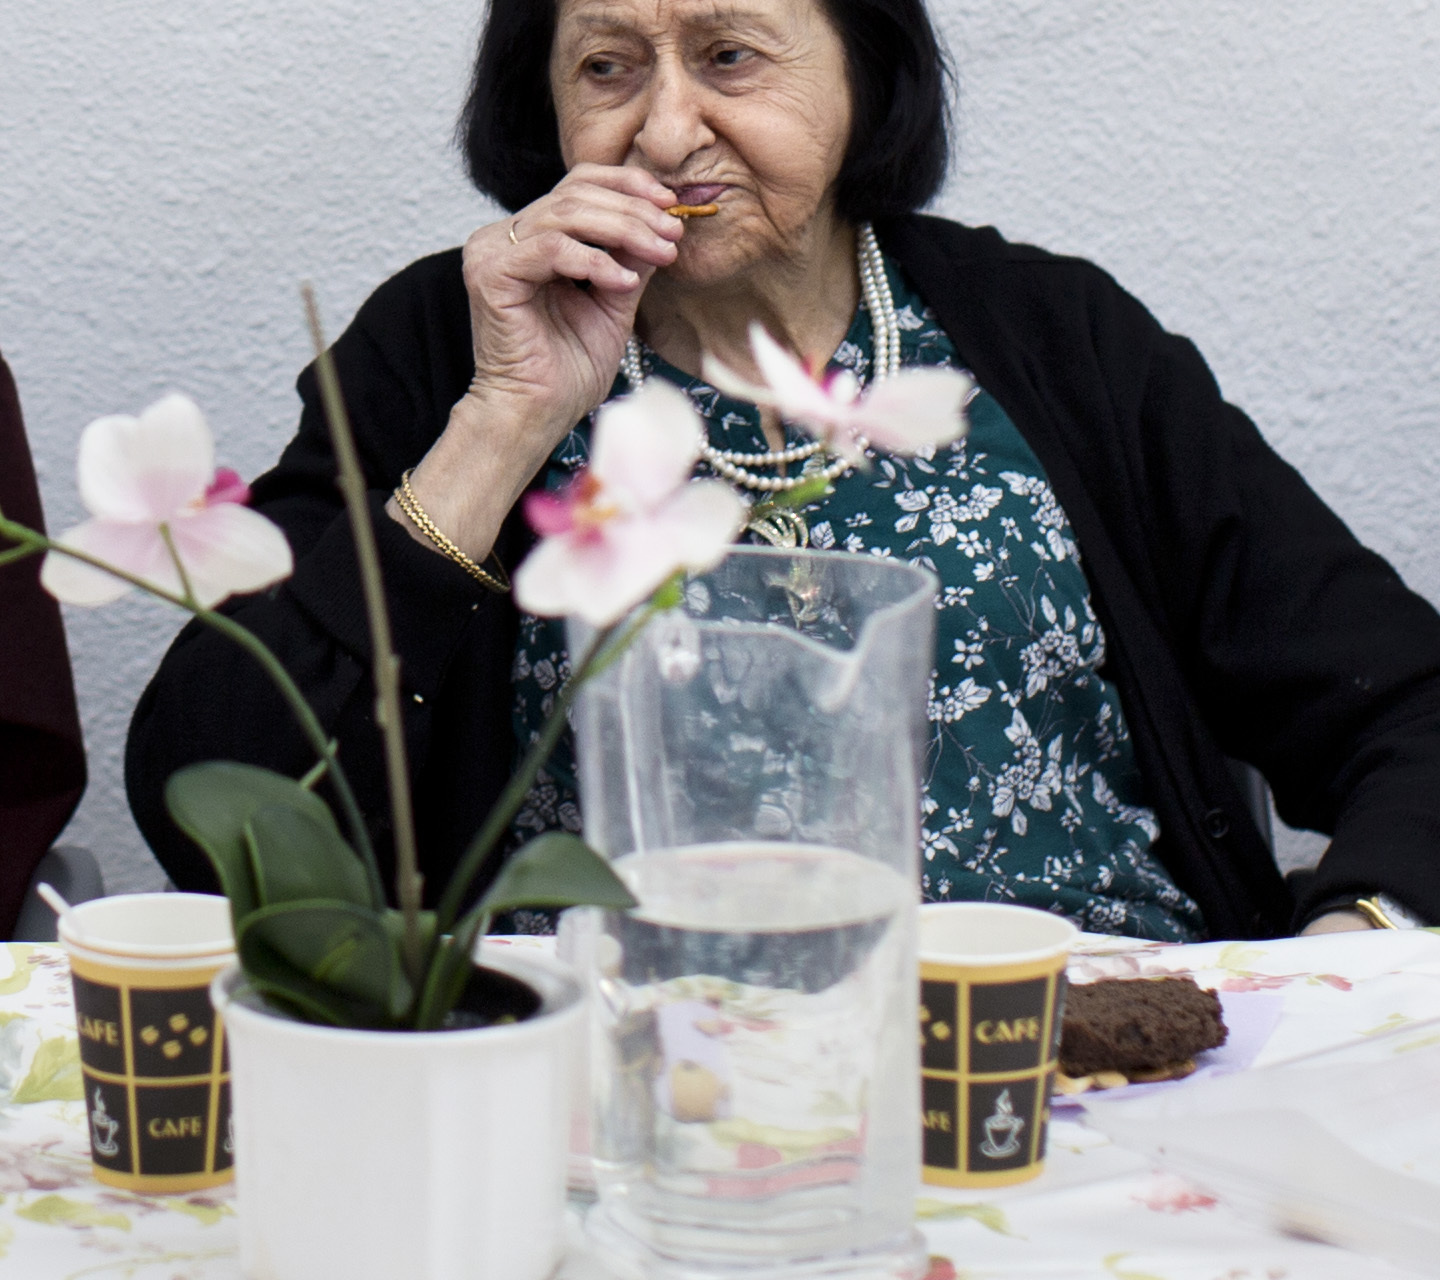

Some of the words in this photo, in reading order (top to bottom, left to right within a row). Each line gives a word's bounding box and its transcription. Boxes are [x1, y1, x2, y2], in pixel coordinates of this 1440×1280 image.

[975, 1016, 1040, 1045] CAFE
[148, 1116, 203, 1138] CAFE
[922, 1110, 951, 1132] AFE
